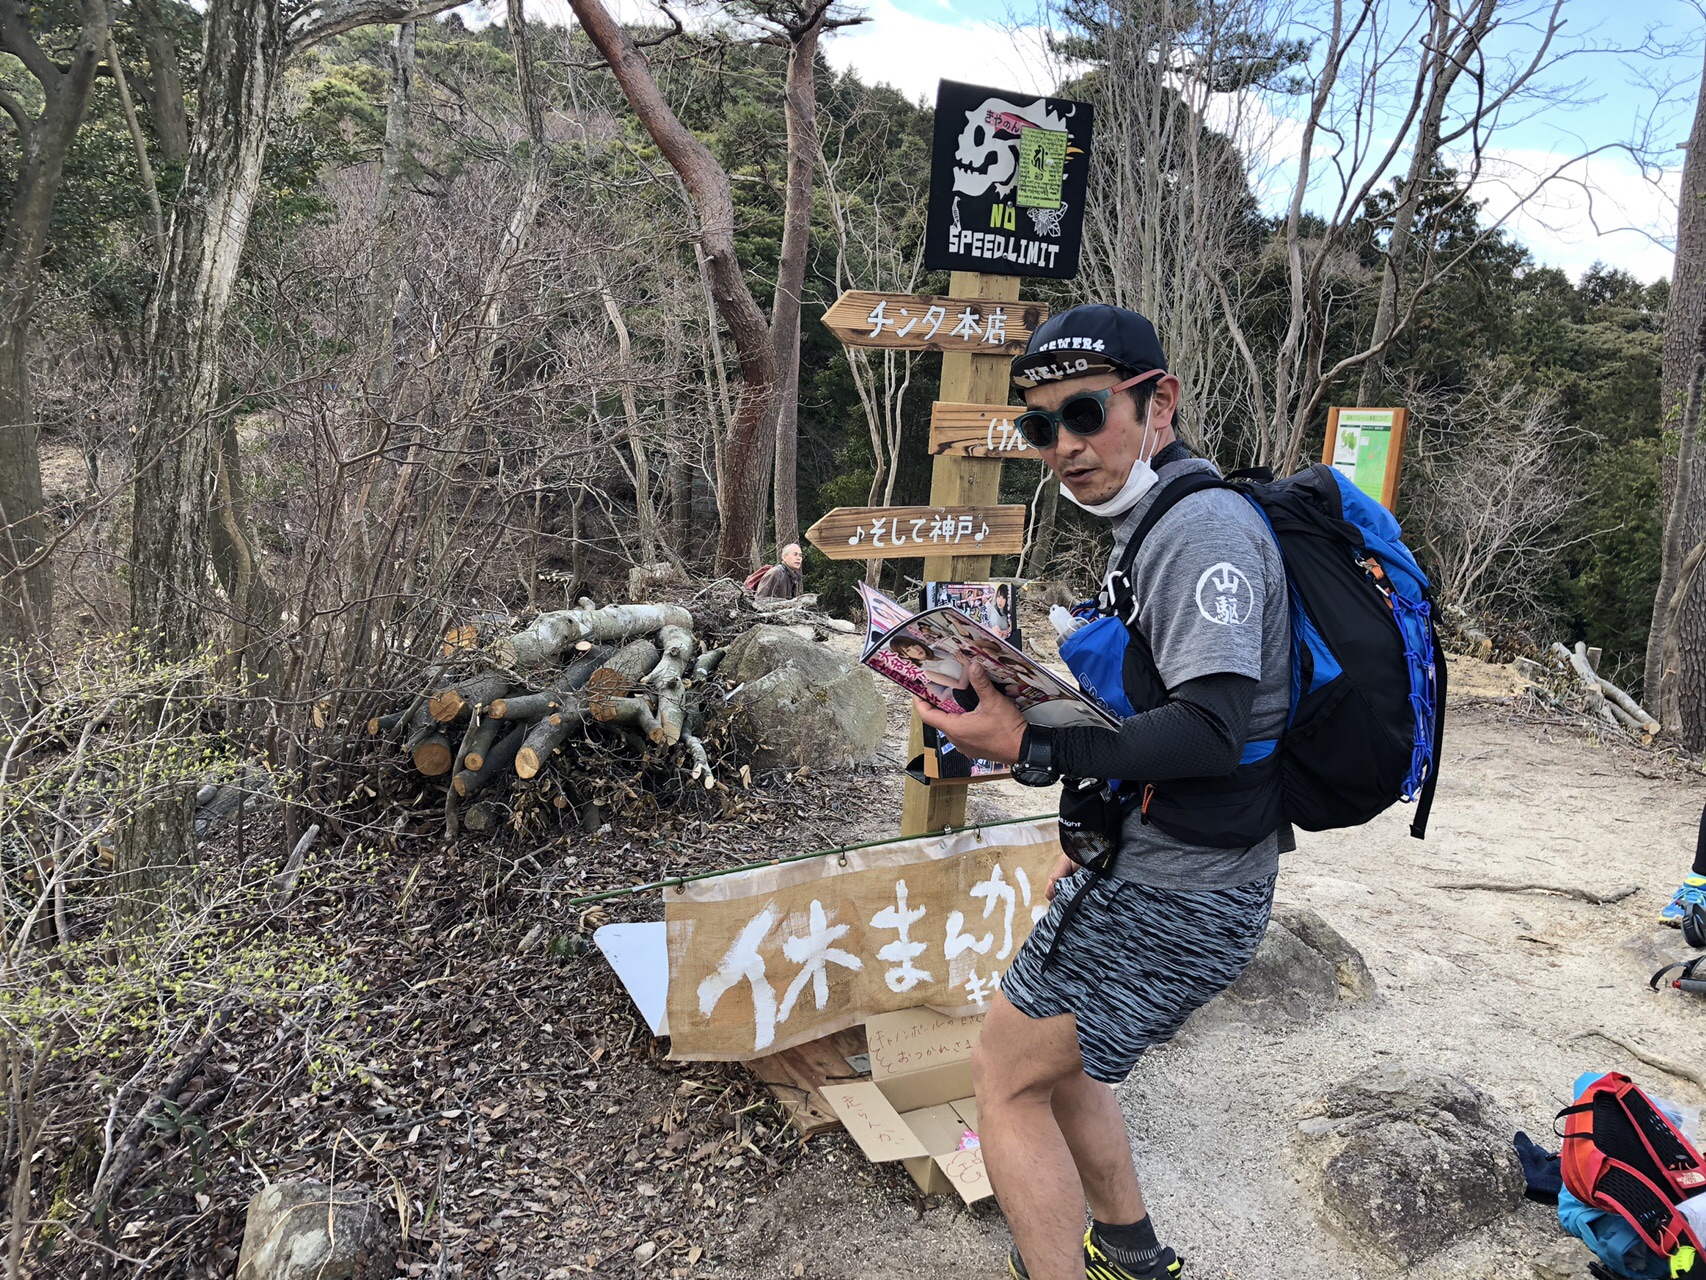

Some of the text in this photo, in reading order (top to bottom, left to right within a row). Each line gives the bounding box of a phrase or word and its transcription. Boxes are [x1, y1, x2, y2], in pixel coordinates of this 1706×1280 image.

[990, 203, 1015, 231] NO
[949, 225, 1060, 269] SPEED LIMIT
[867, 300, 1007, 345] チンタ本店
[1024, 358, 1088, 381] HELLO
[869, 514, 973, 547] そして神戸
[697, 863, 1048, 1051] 休まんか
